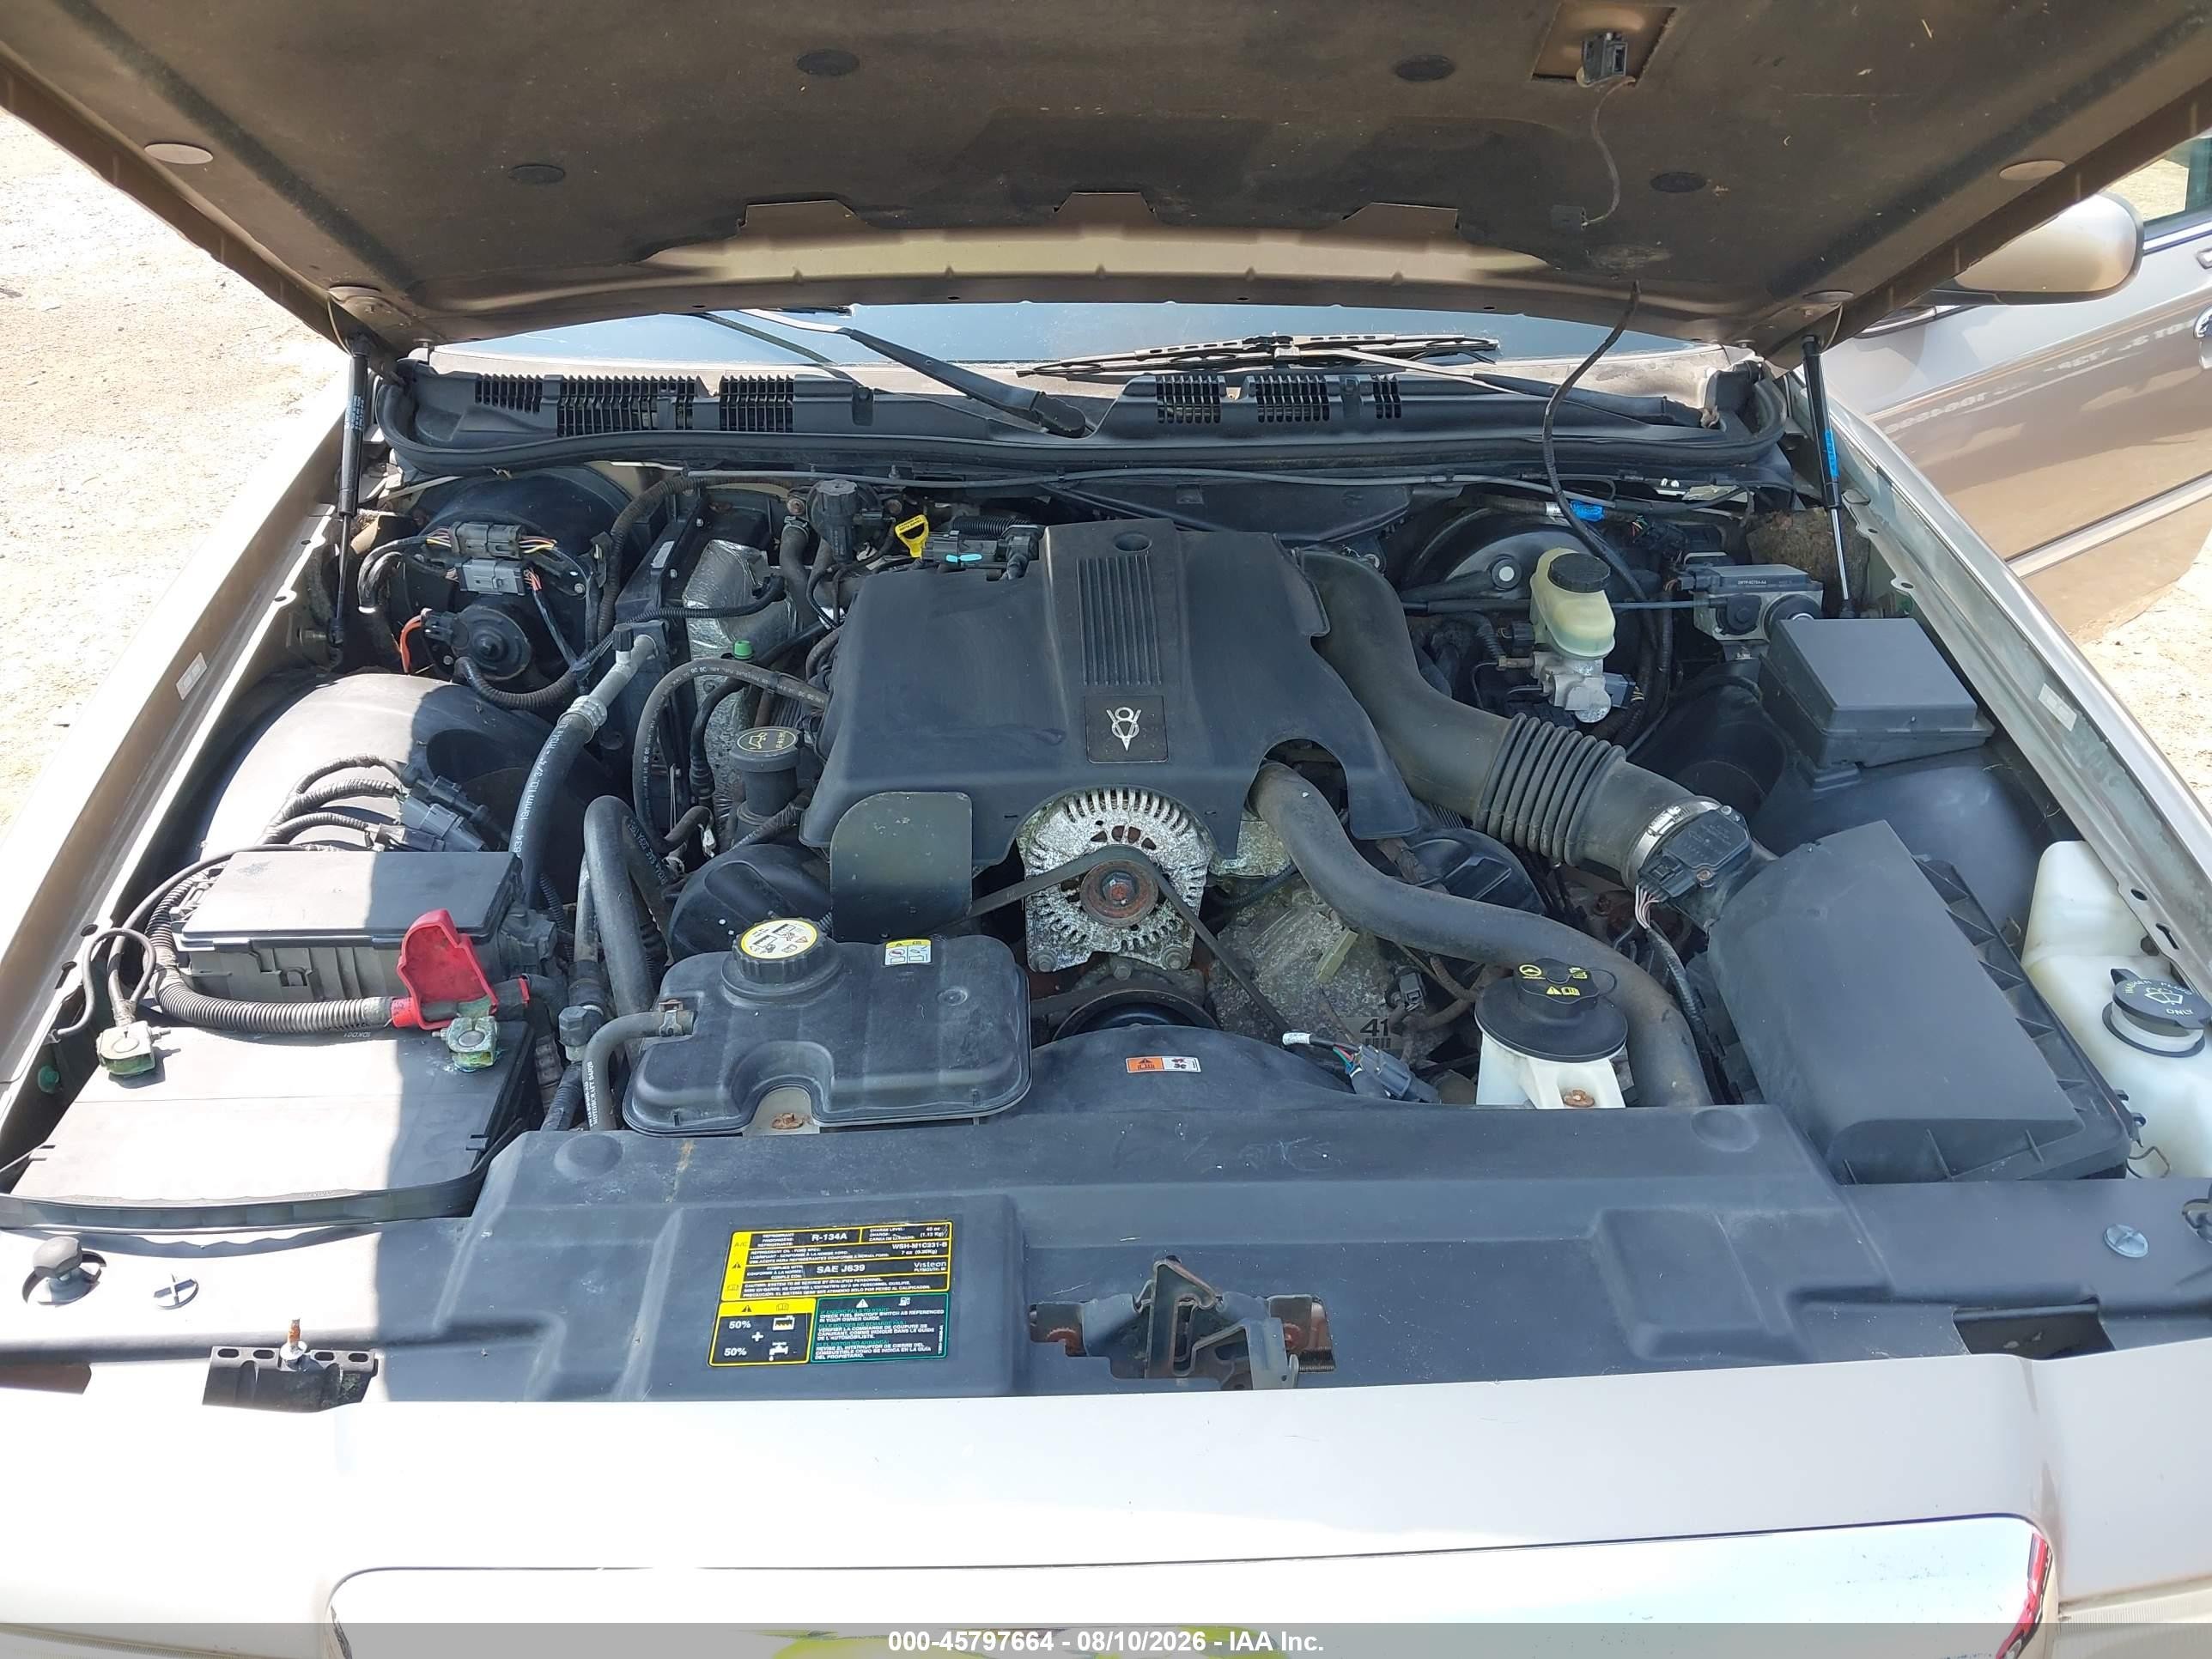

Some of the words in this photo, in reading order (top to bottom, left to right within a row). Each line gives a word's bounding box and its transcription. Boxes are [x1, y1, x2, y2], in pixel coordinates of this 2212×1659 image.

[589, 1081, 599, 1126] MOTORCRAFT
[811, 1232, 848, 1242] R-134A
[841, 1264, 866, 1273] J639
[729, 1320, 751, 1329] 50%
[724, 1347, 747, 1357] 50%
